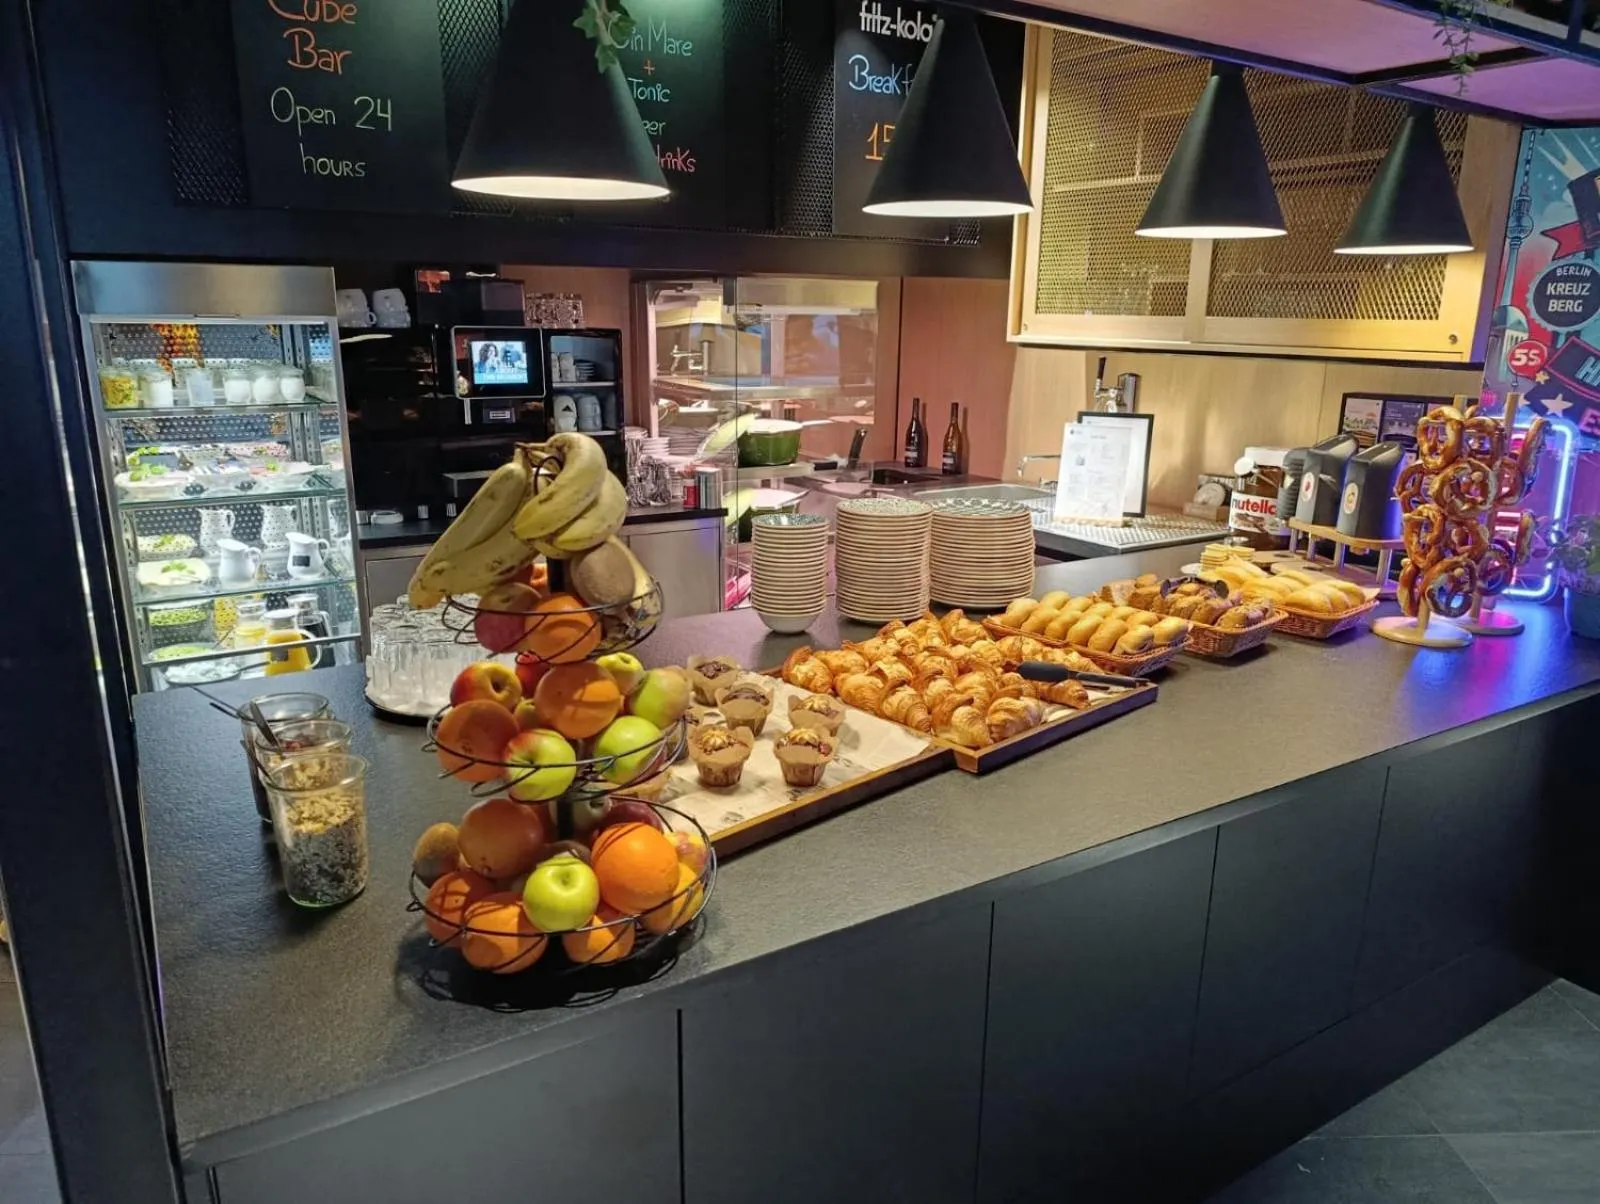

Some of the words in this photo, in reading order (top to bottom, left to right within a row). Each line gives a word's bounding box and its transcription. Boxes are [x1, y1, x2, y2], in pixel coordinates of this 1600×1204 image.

[283, 27, 353, 75] Bar
[648, 19, 693, 57] Mare
[627, 77, 671, 103] Tonic
[271, 86, 336, 137] Open
[353, 96, 392, 132] 24
[1556, 266, 1592, 277] BERLIN
[1546, 282, 1591, 296] KREUZ
[1547, 299, 1583, 313] BERG
